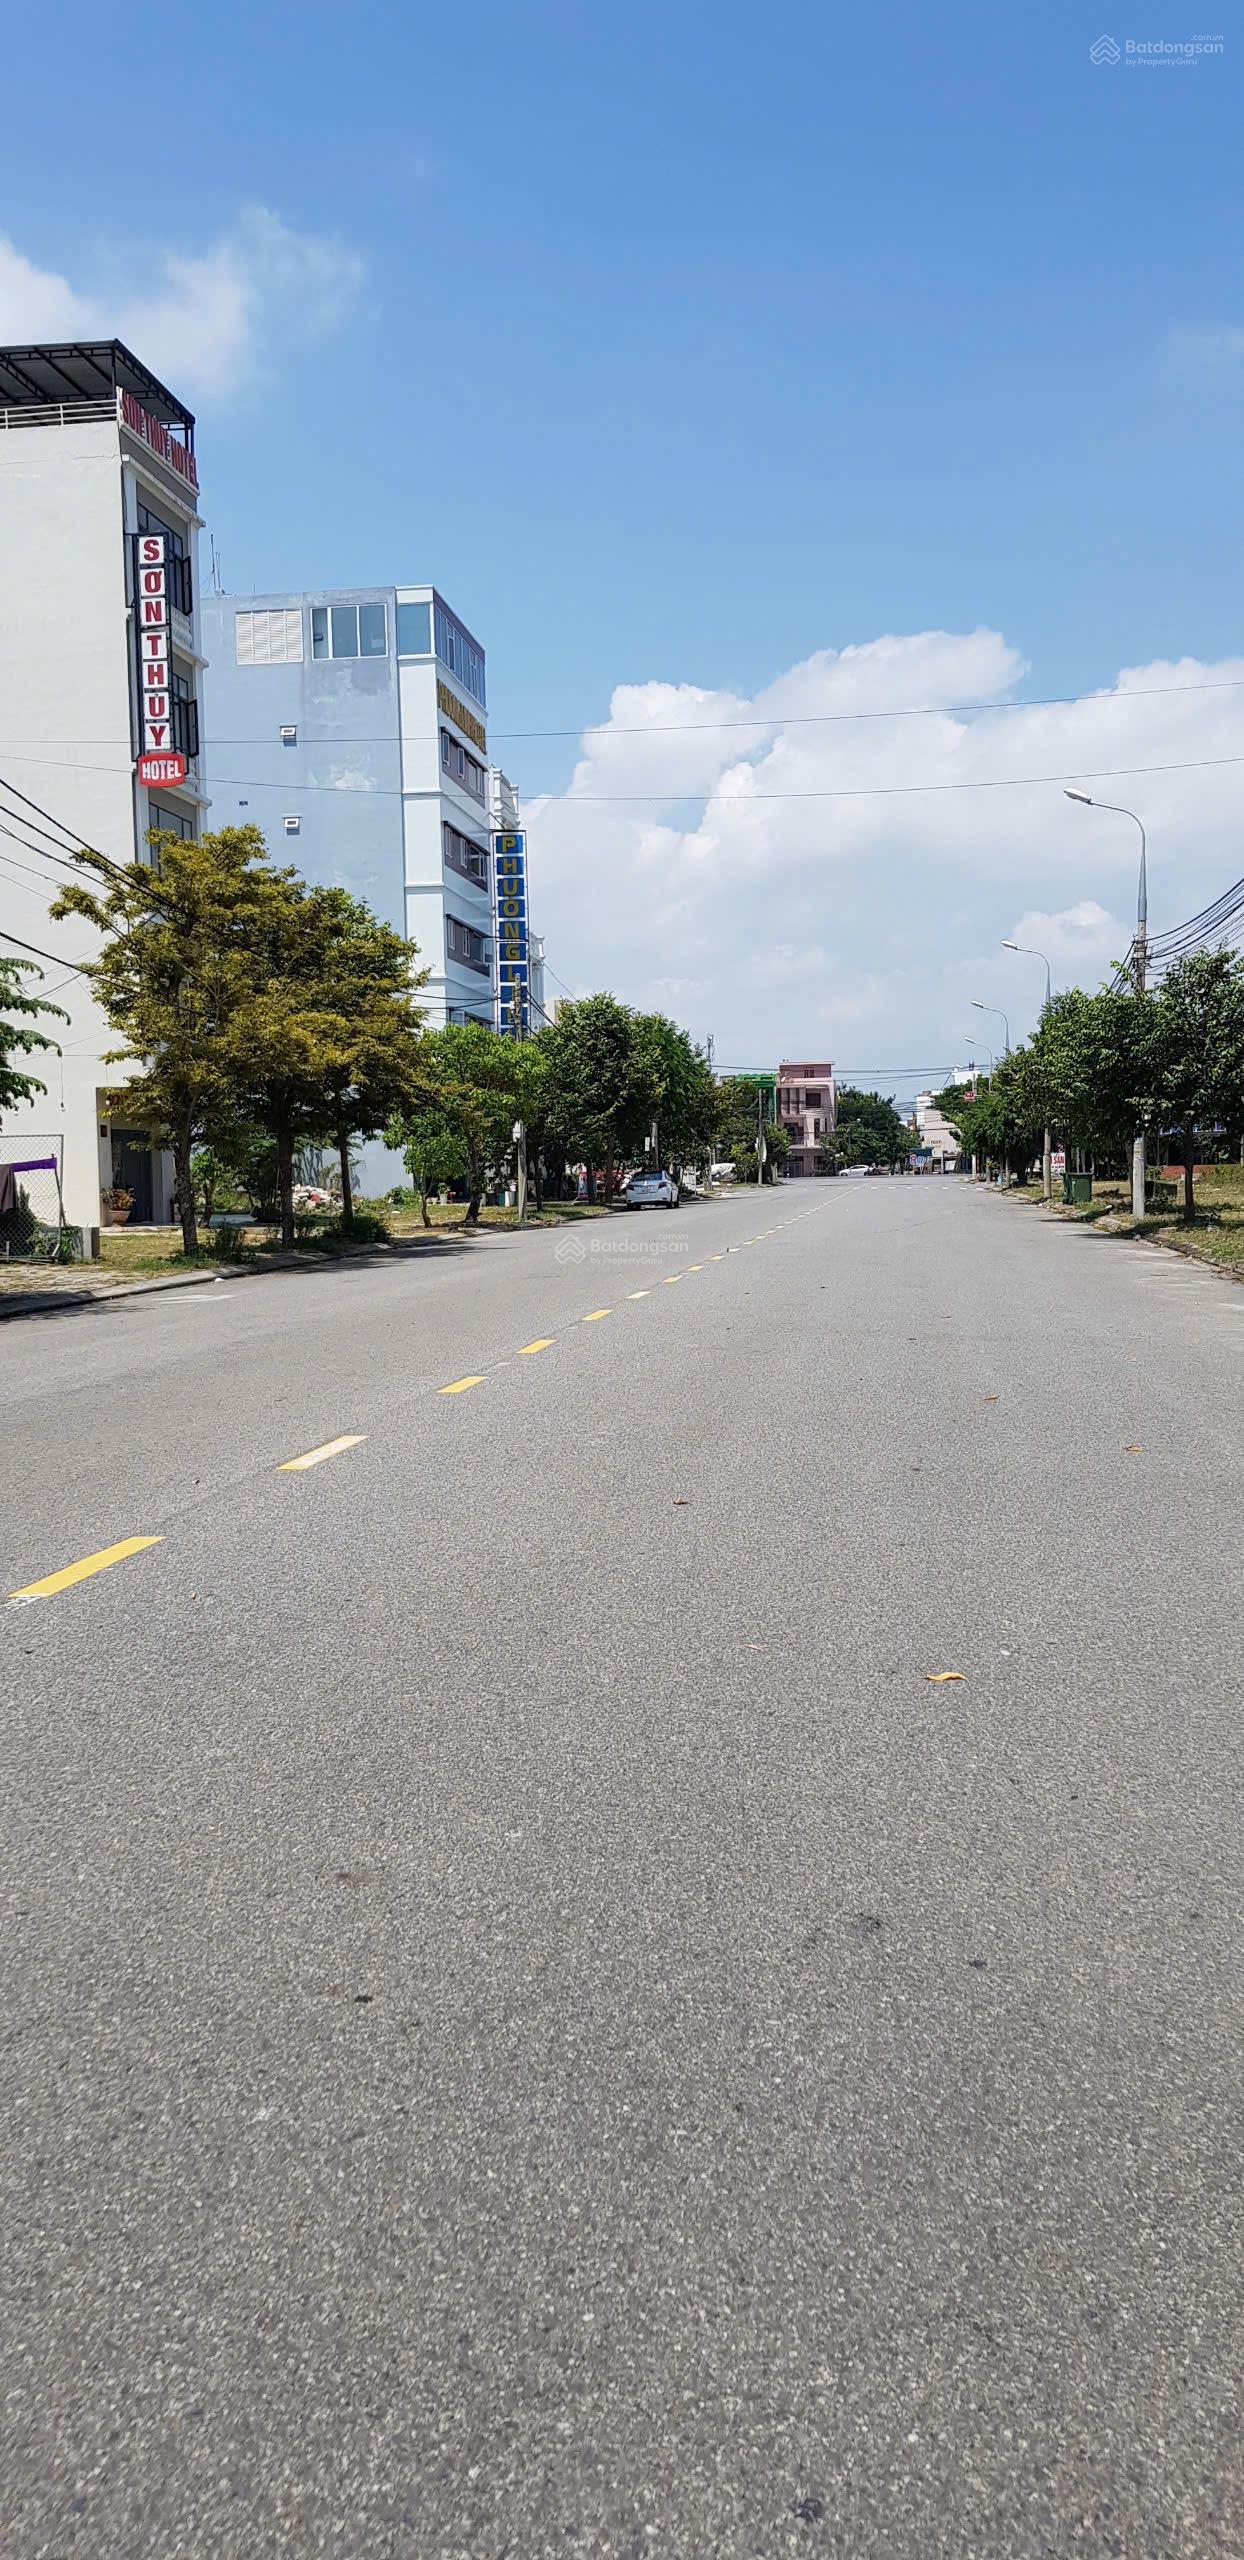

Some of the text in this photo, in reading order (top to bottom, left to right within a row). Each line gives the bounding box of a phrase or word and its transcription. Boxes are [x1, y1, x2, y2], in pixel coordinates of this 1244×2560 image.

[143, 539, 168, 747] SƠN THỦY
[142, 760, 182, 780] HOTEL
